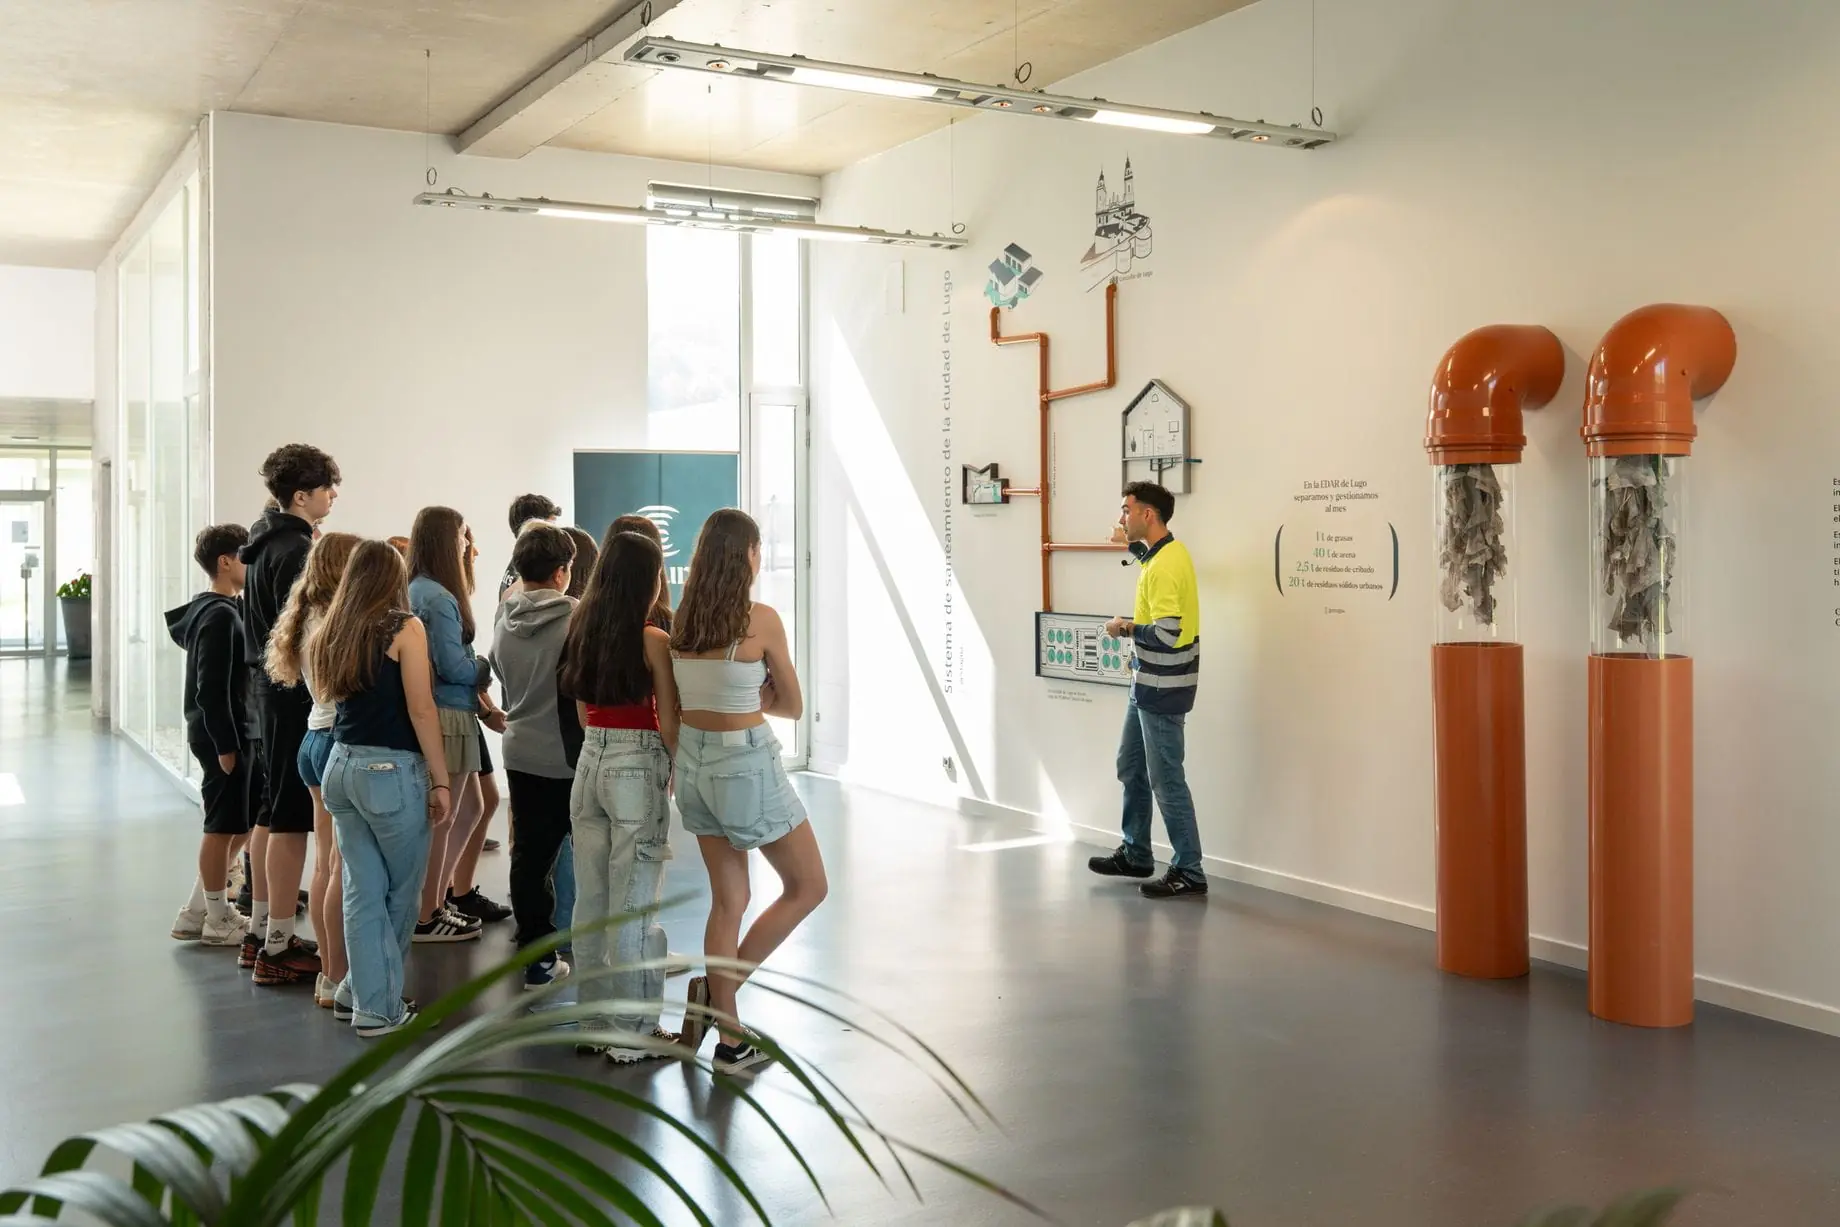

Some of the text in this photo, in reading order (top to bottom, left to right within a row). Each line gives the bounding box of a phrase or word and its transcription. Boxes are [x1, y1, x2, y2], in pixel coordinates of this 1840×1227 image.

[942, 269, 953, 694] Sistema de saneamiento de la ciudad de Lugo
[1303, 479, 1368, 489] En la EDAR de Lugo
[1294, 493, 1329, 503] separamos
[1335, 491, 1379, 501] gestionamos
[1325, 504, 1347, 513] al mes
[1312, 547, 1325, 558] 40
[1296, 561, 1309, 572] 2,5
[1288, 576, 1300, 587] 20
[1306, 580, 1314, 588] de
[1359, 582, 1383, 590] urbanos
